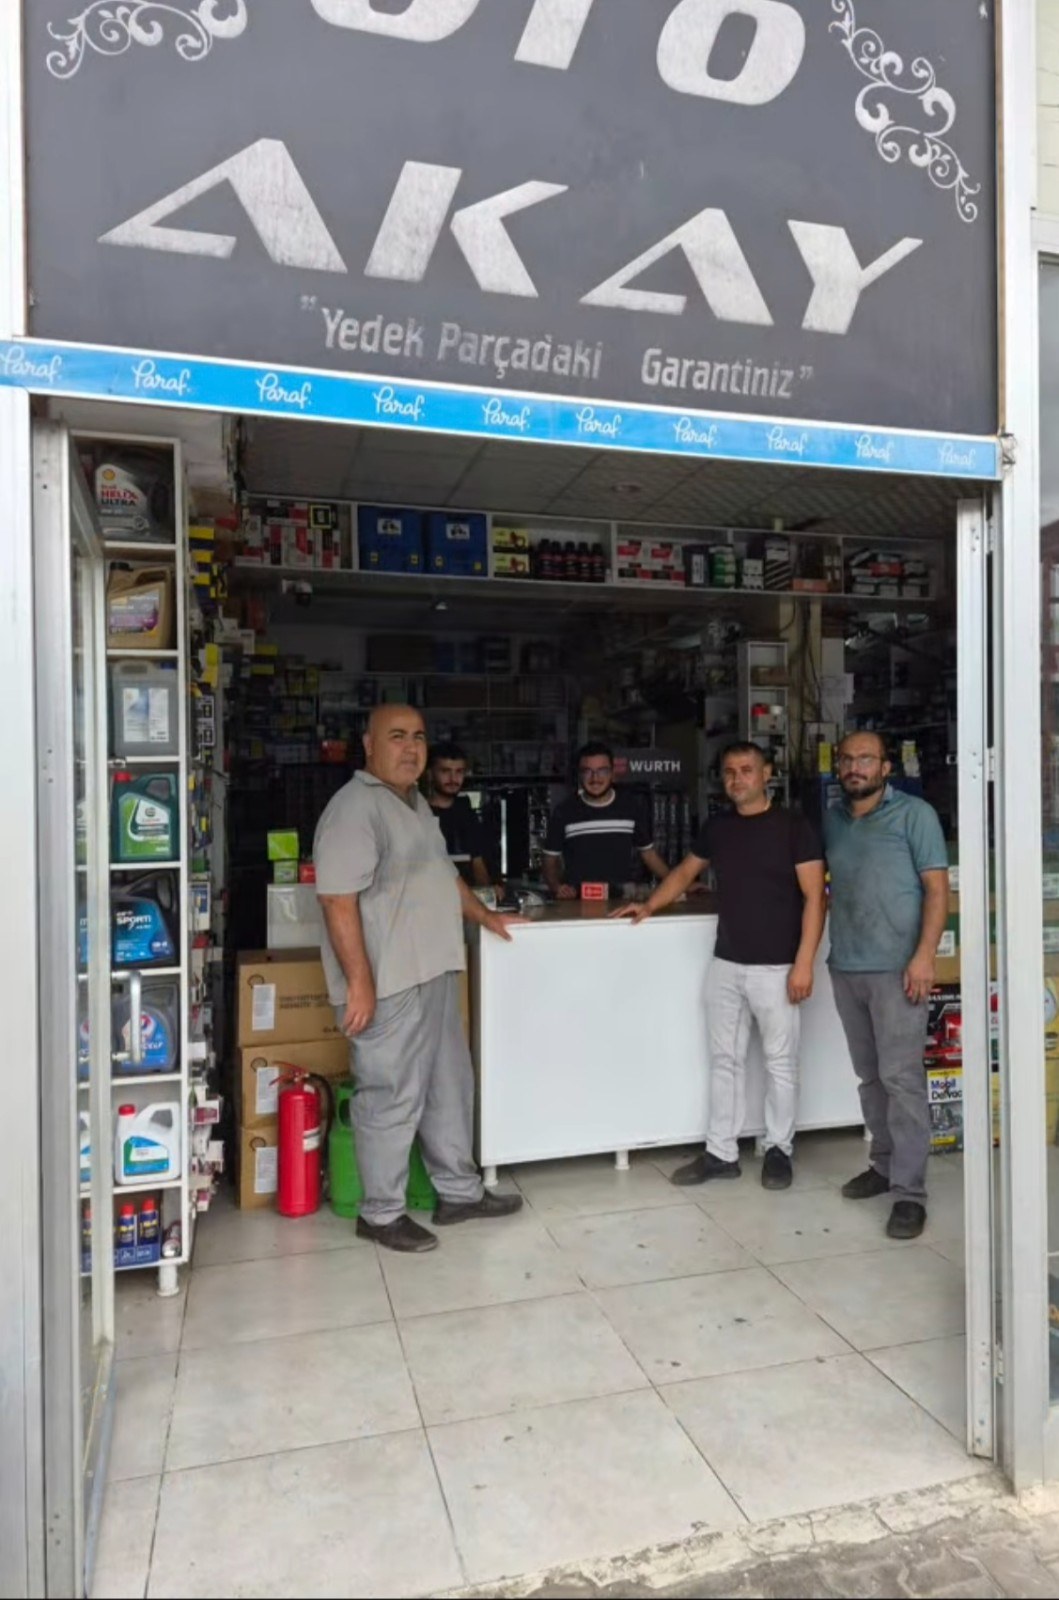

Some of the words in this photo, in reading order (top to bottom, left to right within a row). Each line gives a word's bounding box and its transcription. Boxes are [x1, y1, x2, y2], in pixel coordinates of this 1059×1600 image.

[97, 137, 923, 335] AKAY
[437, 321, 603, 379] Parçadaki
[931, 1078, 956, 1090] Mobil
